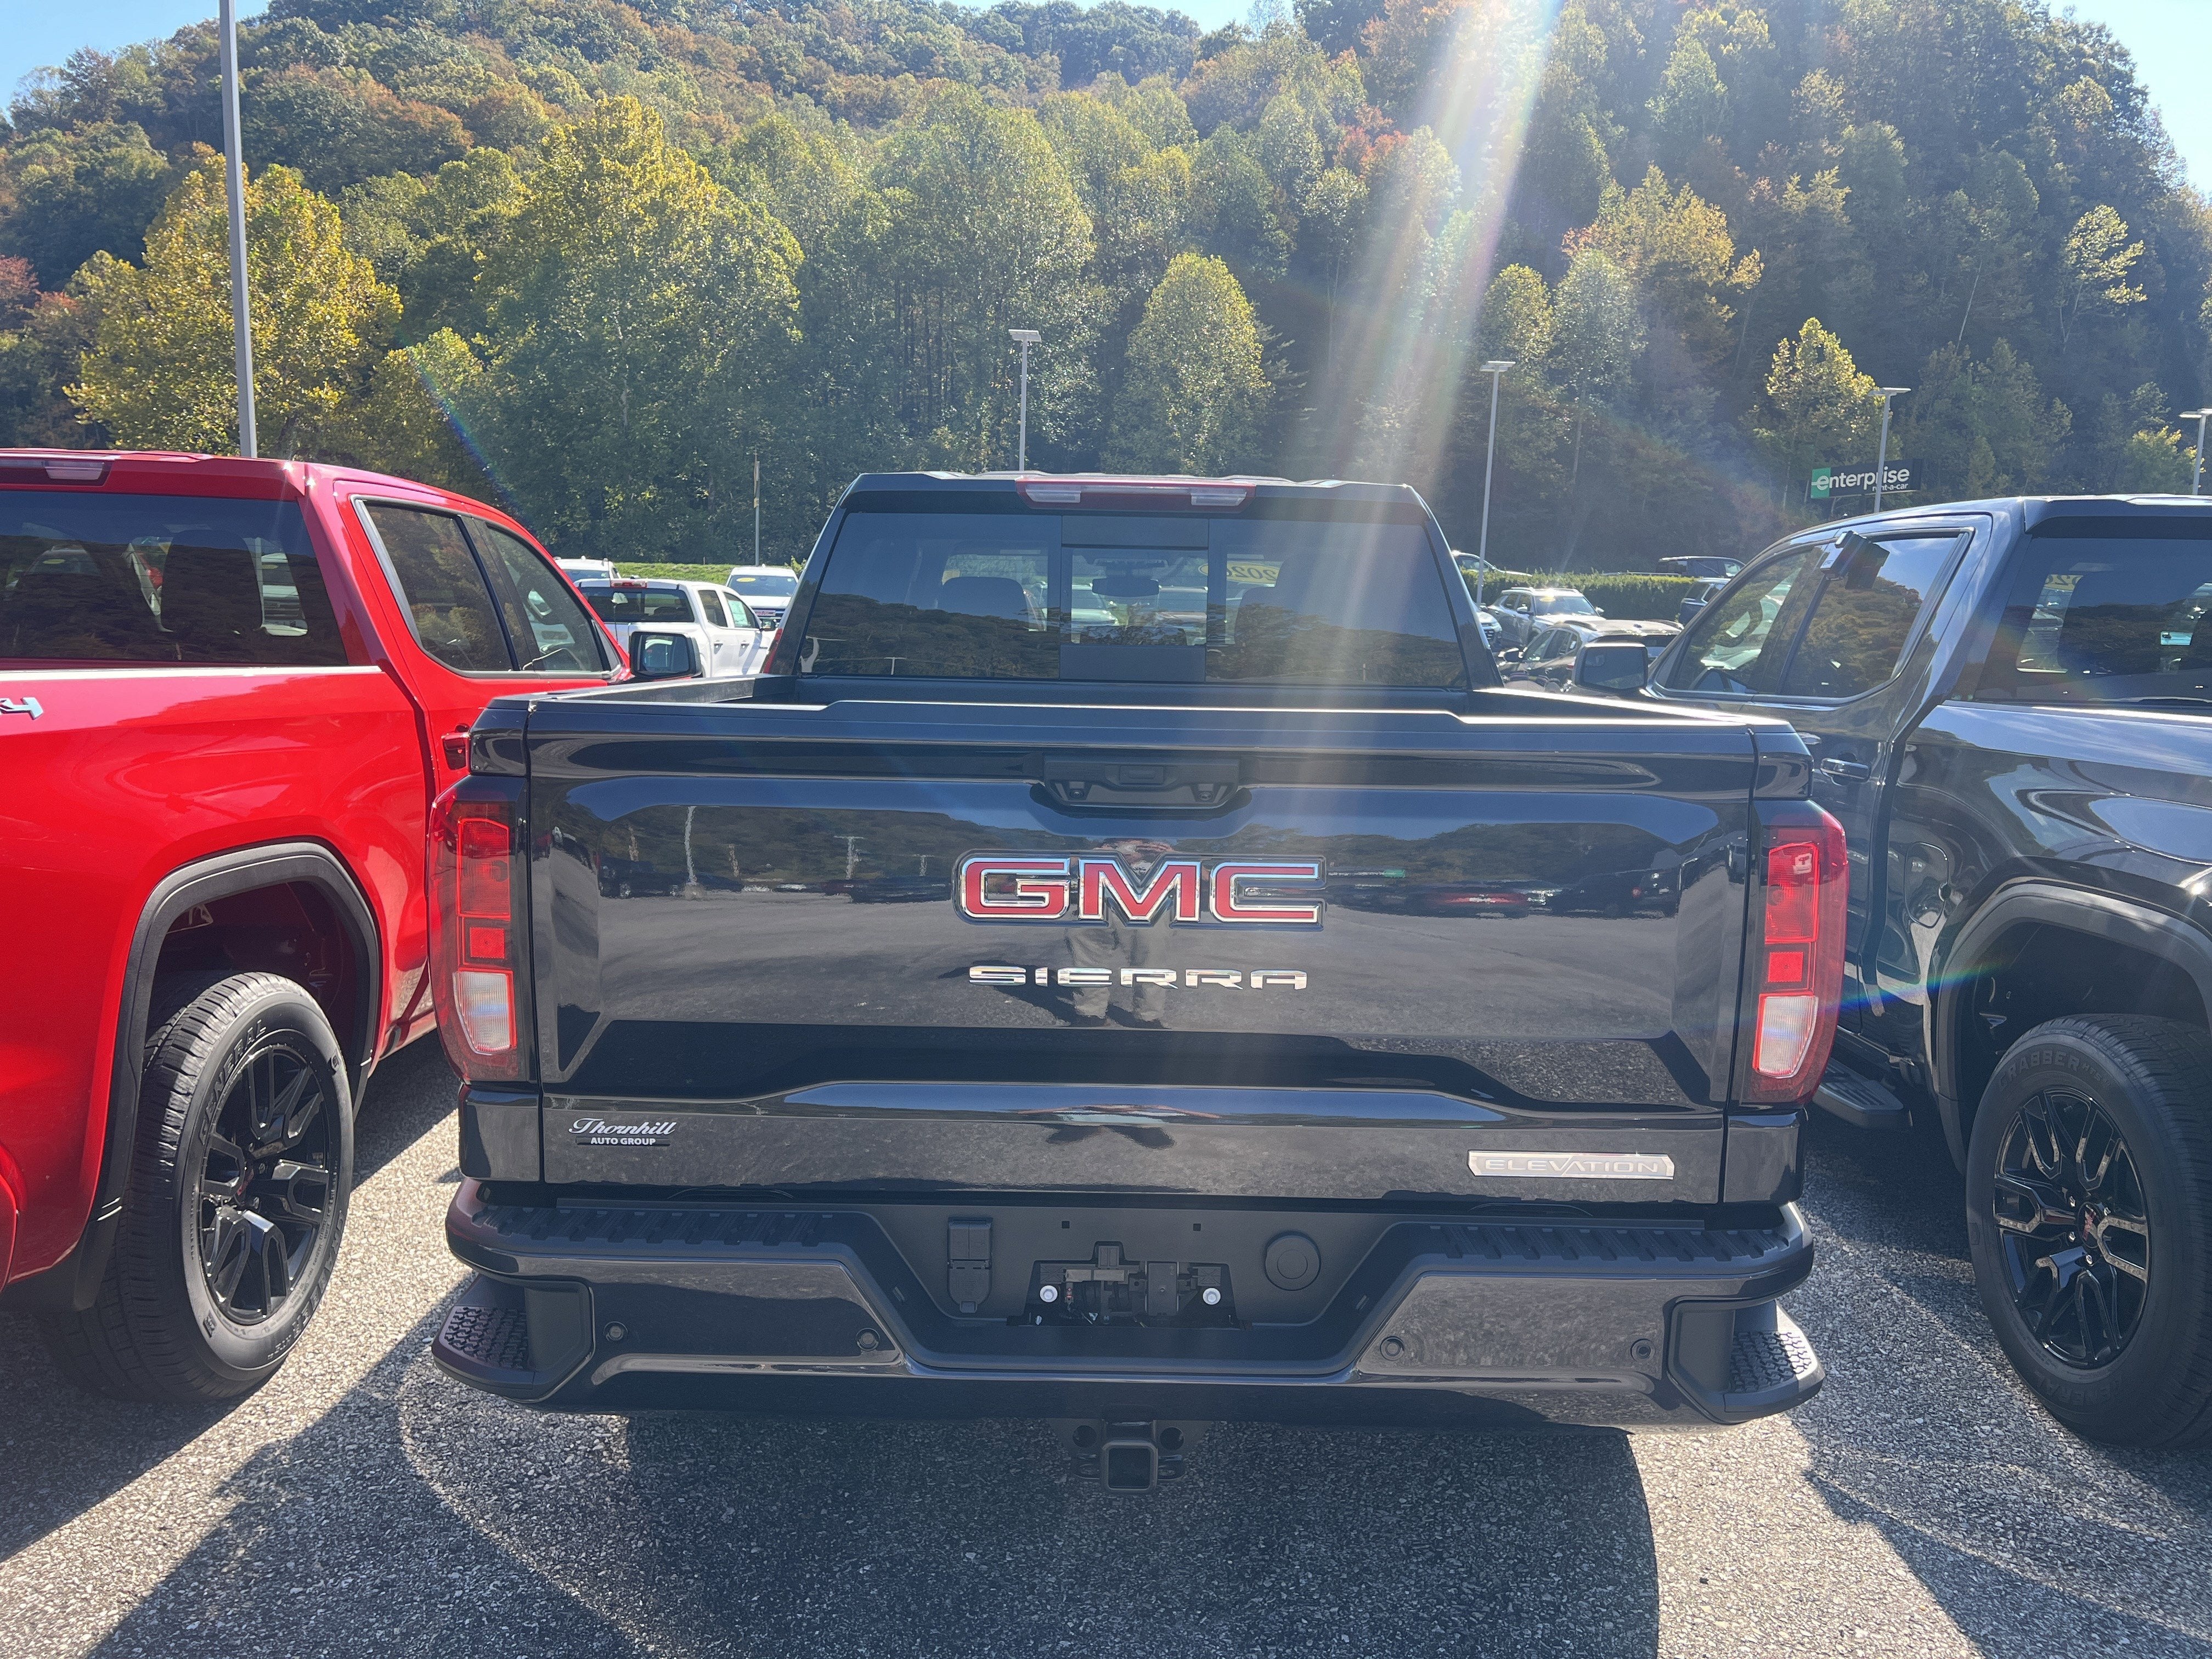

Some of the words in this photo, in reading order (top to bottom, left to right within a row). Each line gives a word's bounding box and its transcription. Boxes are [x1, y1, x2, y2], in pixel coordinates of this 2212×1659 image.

[1872, 483, 1909, 492] rnt-a-car
[960, 857, 1319, 923] GMC
[969, 965, 1308, 990] SIERRA
[568, 1118, 677, 1135] Thornhill
[590, 1137, 618, 1145] AUTO
[620, 1137, 656, 1146] GROUP
[1485, 1156, 1658, 1174] ELEVATION
